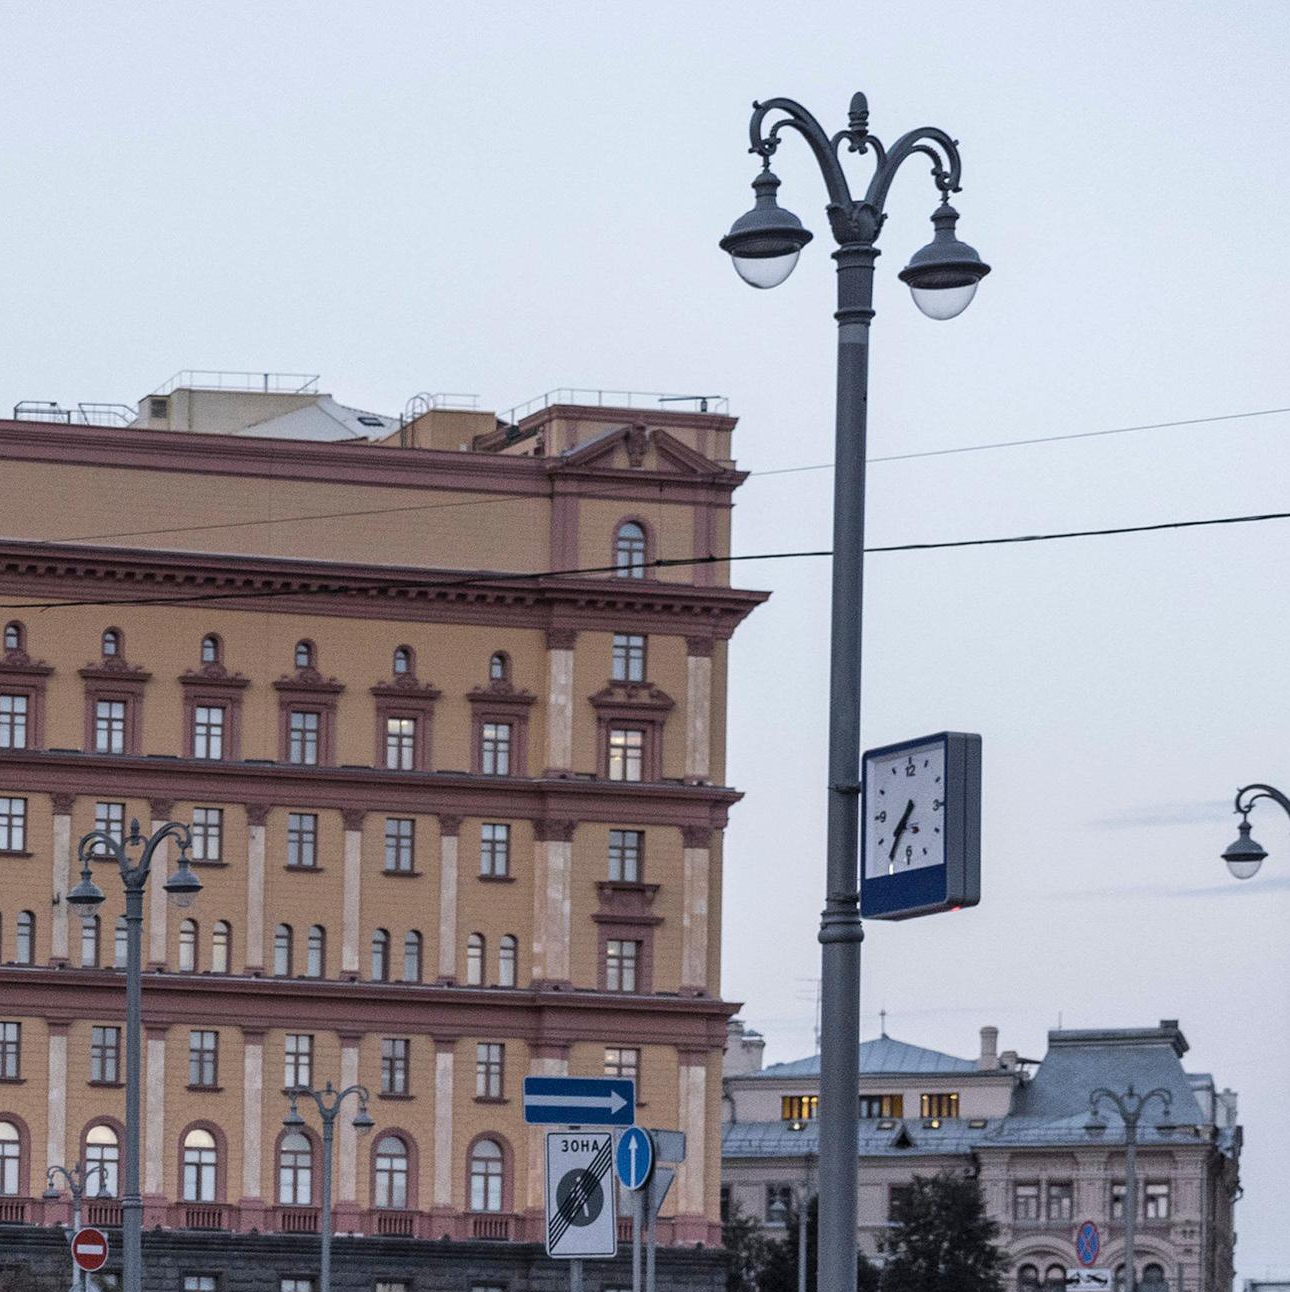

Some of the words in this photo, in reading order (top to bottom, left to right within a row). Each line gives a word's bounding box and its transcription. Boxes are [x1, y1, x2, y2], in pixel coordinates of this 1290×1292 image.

[906, 764, 916, 777] 12
[933, 799, 941, 811] 3
[880, 811, 887, 823] 9
[905, 845, 912, 858] 6
[561, 1140, 600, 1152] ЗОНА
